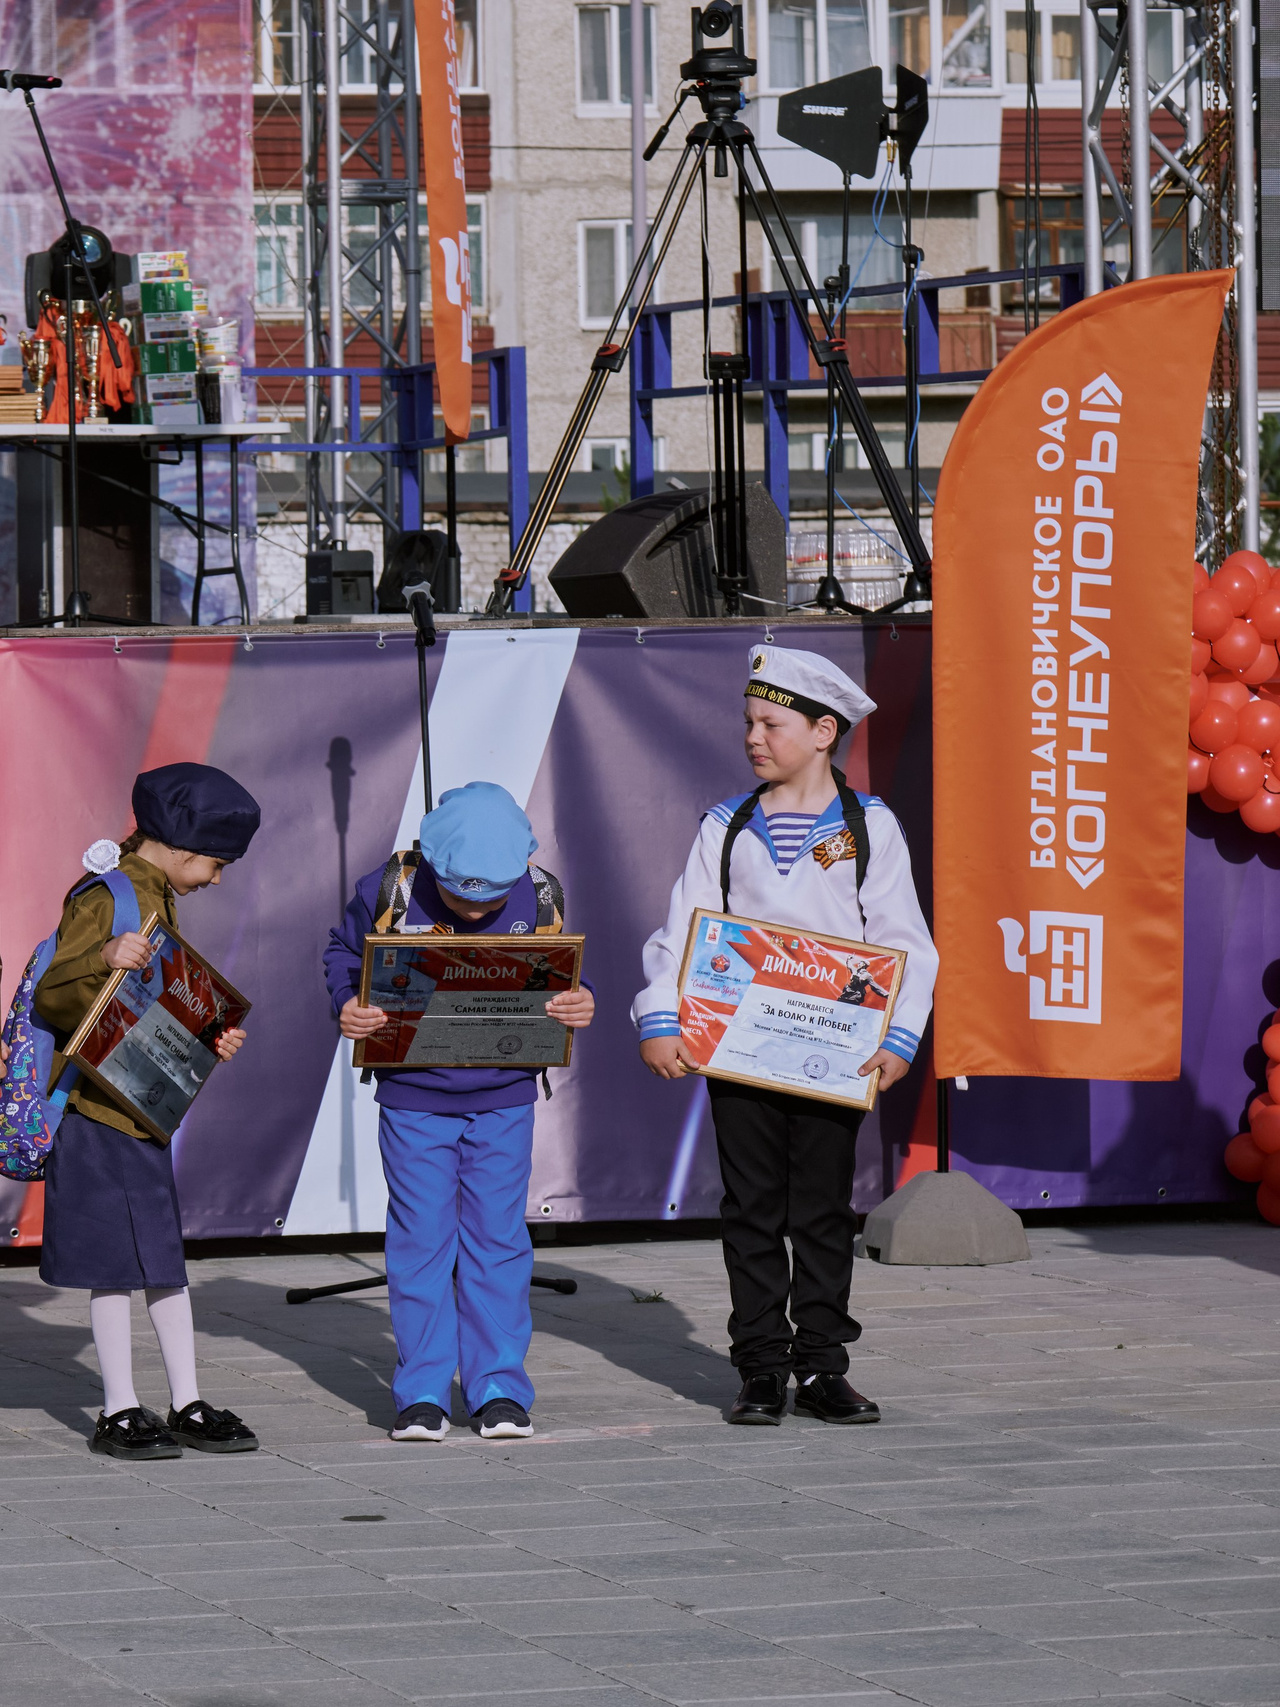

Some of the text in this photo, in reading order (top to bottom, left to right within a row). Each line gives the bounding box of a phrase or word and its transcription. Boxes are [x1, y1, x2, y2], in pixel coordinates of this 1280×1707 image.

[802, 105, 846, 117] SHURE
[1029, 386, 1070, 869] БОГДАНОВИЧСКОЕ ОАО
[768, 690, 794, 706] ФЛОТ
[442, 966, 517, 980] ДИПЛОМ
[761, 955, 837, 984] ДИПЛОМ
[168, 977, 209, 1020] ДИПЛОМ
[786, 998, 834, 1015] НАГРАЖДАЕТСЯ
[687, 1018, 709, 1028] ПАМЯТЬ
[689, 1010, 716, 1021] ТРАДИЦИИ
[685, 1026, 702, 1035] ЧЕСТЬ
